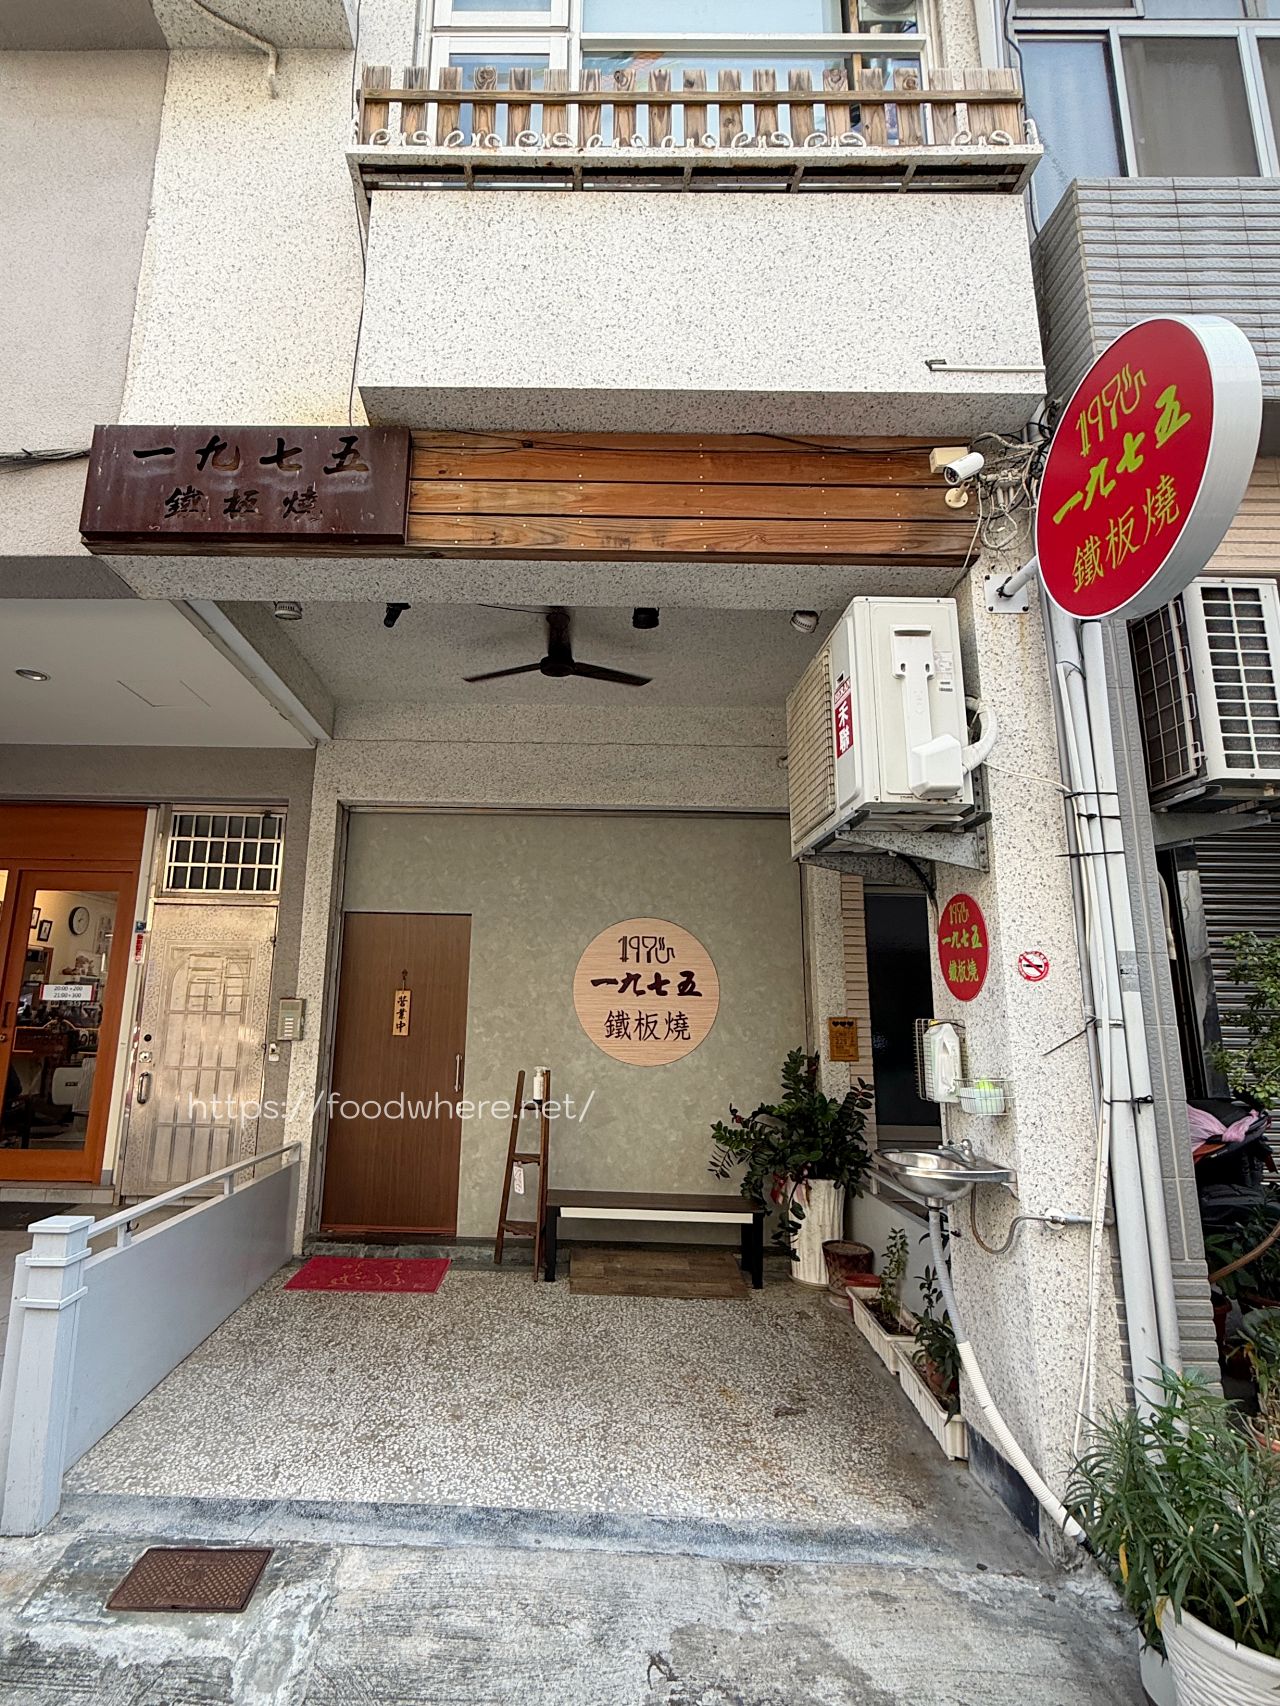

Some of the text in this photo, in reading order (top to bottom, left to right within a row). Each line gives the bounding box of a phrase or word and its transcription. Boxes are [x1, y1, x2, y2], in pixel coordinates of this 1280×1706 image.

[133, 435, 369, 475] 一九七五
[1053, 385, 1192, 524] 一九七五
[165, 485, 323, 521] 鐵板燒
[1072, 475, 1179, 592] 鐵板燒
[942, 925, 982, 949] 一九七五
[591, 971, 702, 996] 一九七五
[604, 1010, 691, 1041] 鐵板燒
